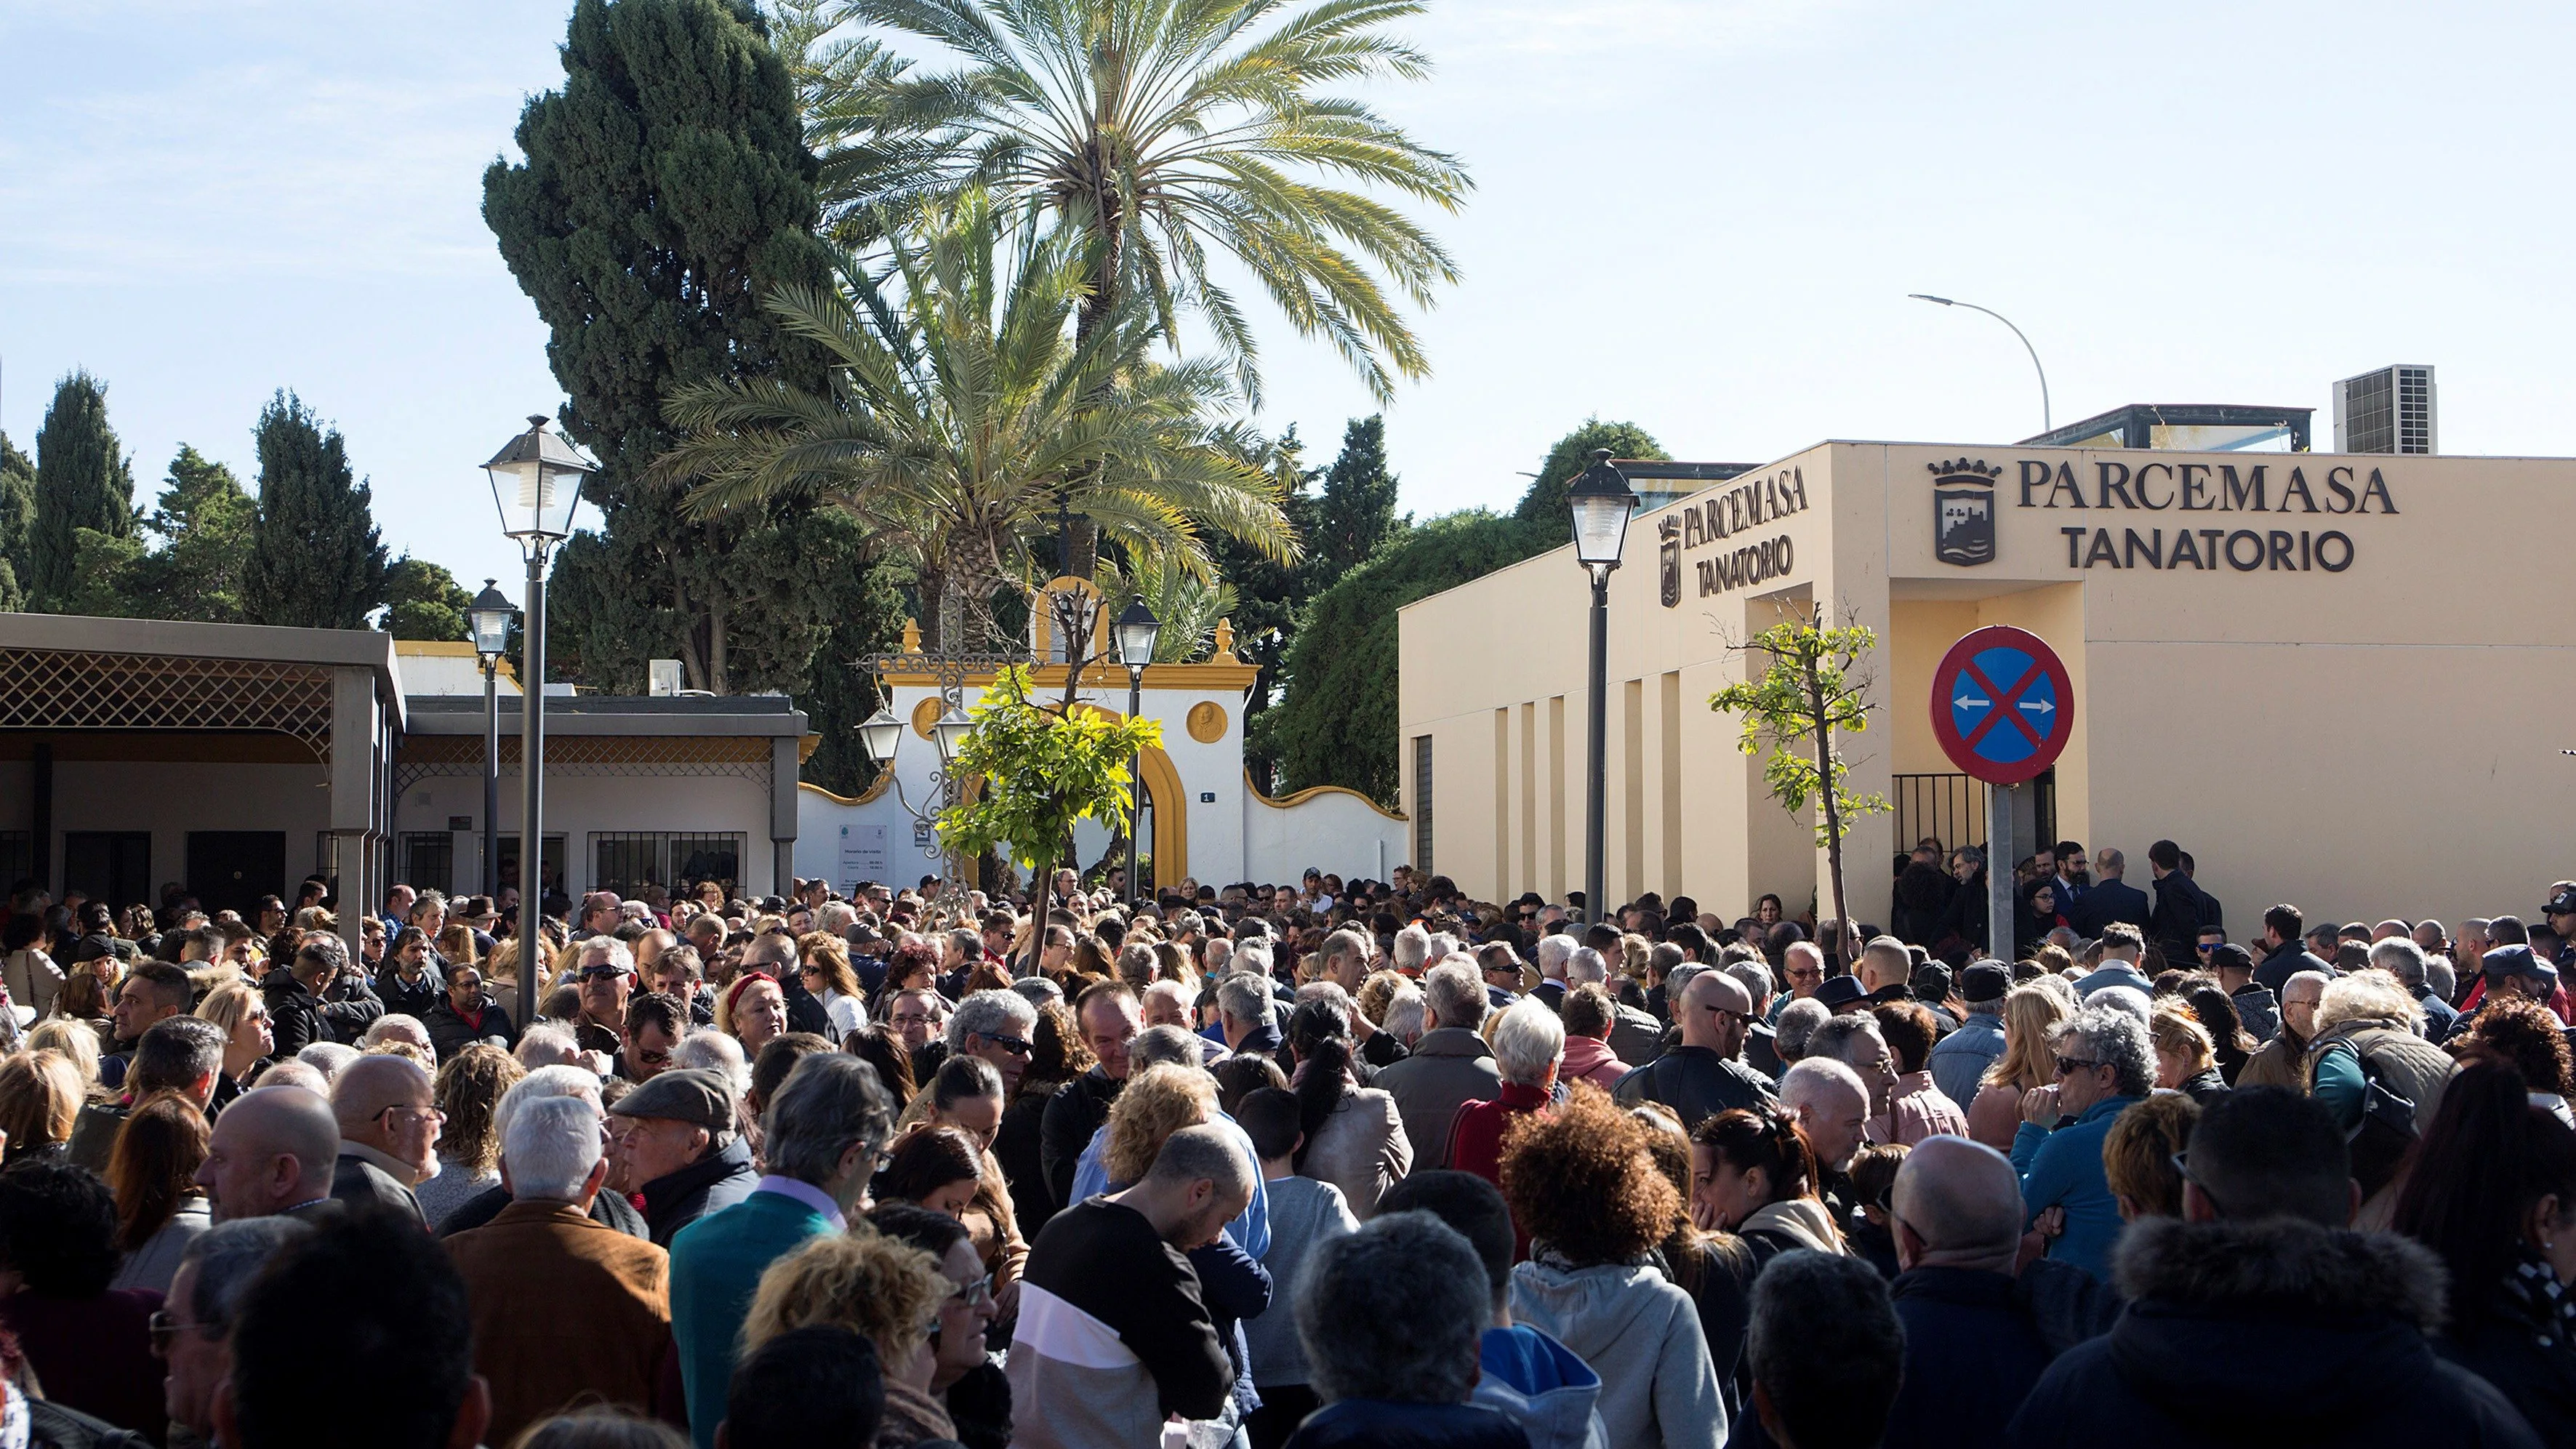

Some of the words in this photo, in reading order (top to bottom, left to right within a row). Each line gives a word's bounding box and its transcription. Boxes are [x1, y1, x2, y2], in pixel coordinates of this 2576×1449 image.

[1683, 464, 1810, 550] PARCEMASA
[2017, 459, 2400, 515] PARCEMASA
[1696, 534, 1794, 598] TANATORIO
[2061, 527, 2355, 572] TANATORIO
